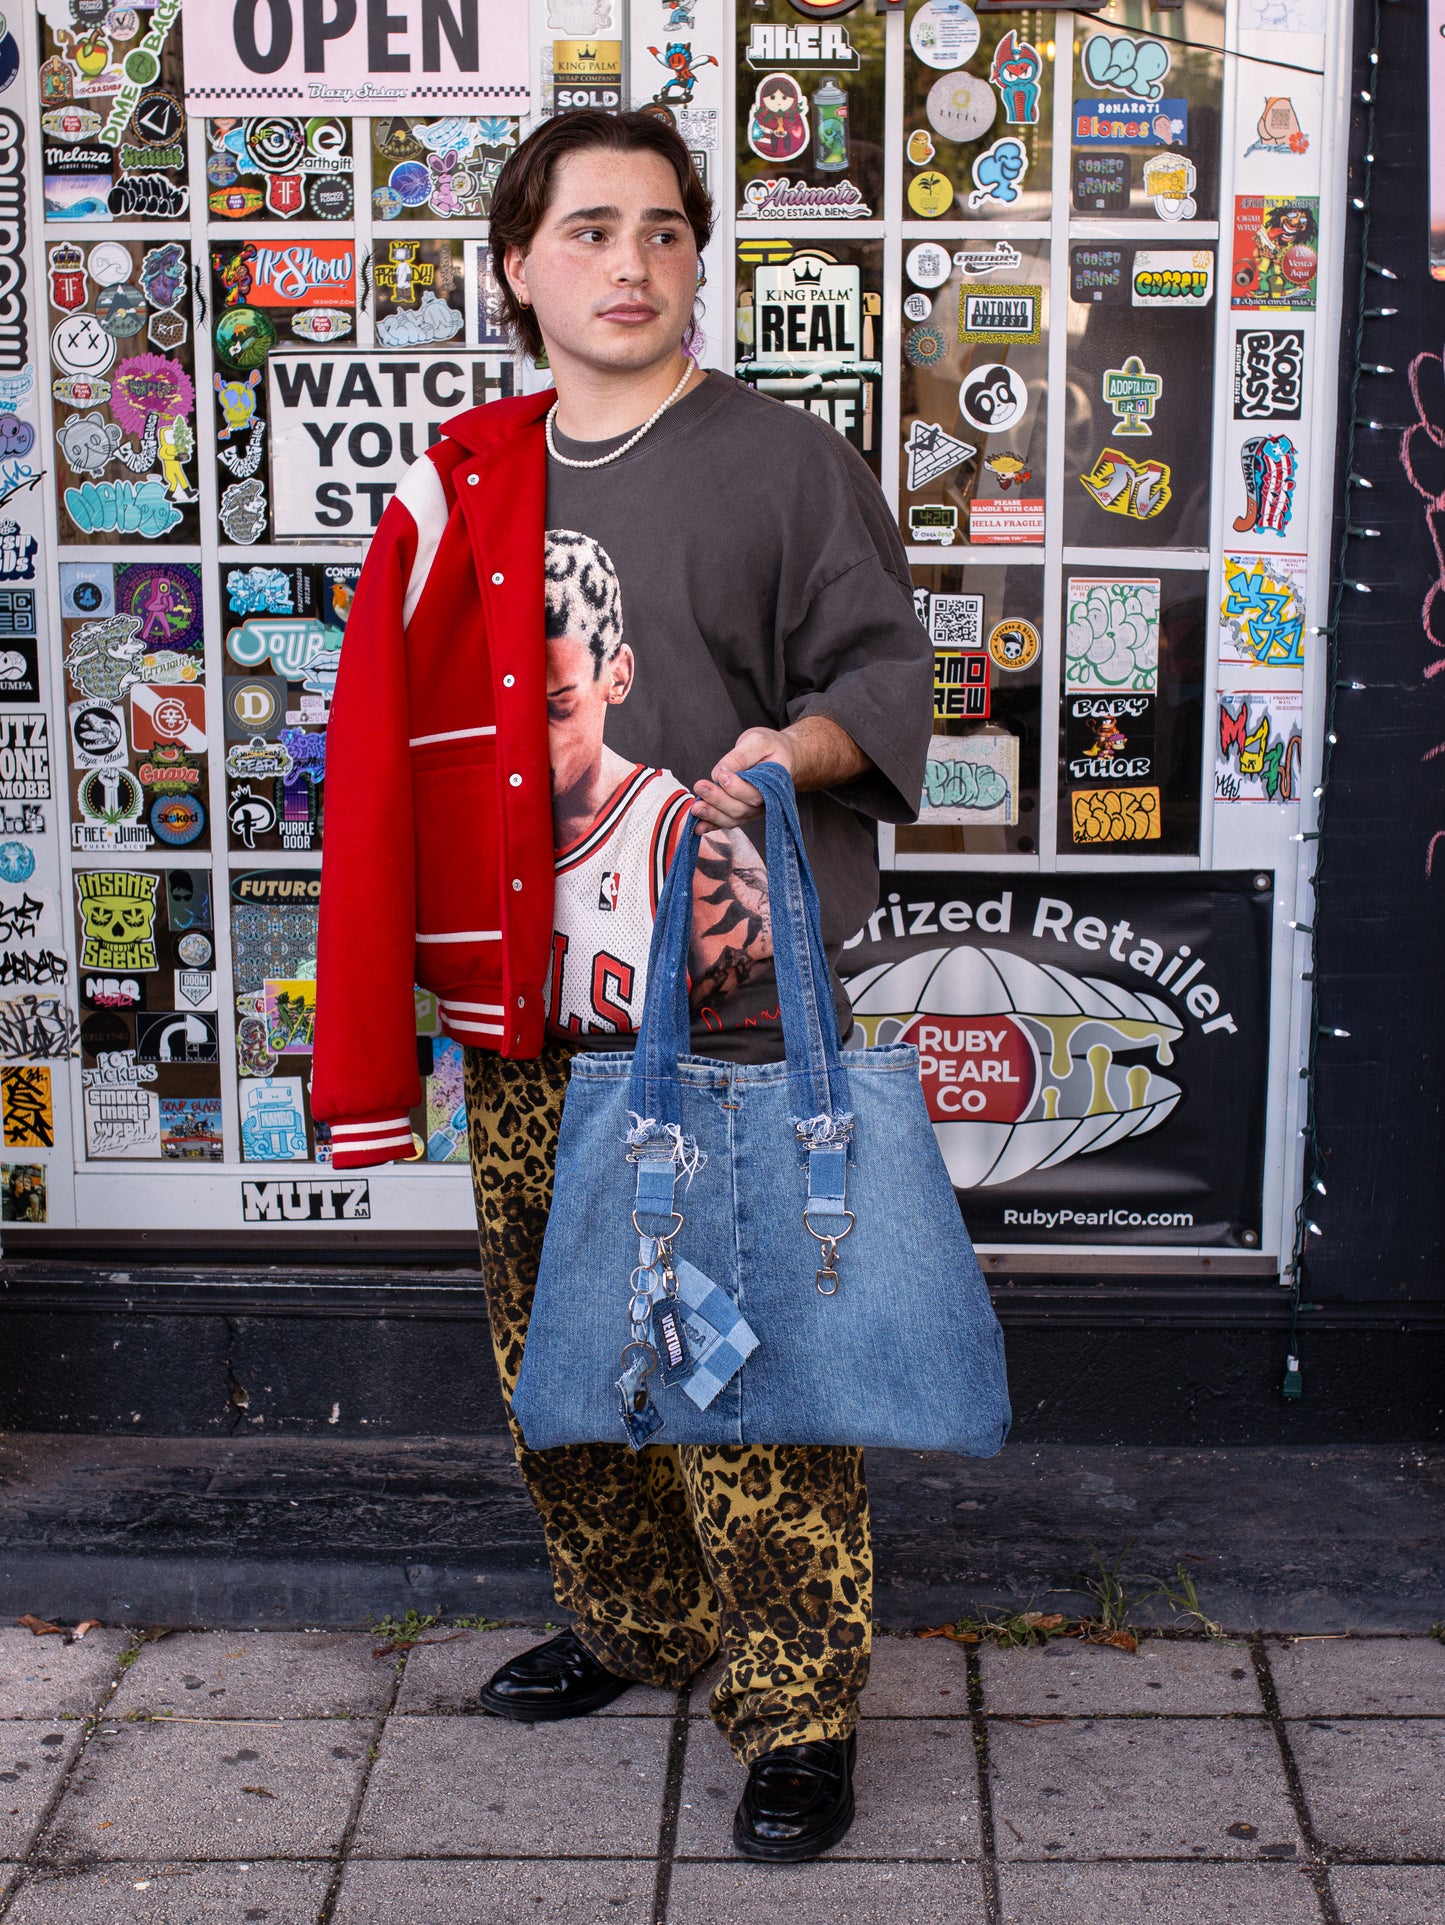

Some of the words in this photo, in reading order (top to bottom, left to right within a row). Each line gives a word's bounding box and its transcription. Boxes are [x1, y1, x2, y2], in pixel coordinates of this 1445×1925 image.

[233, 0, 480, 73] OPEN
[558, 61, 588, 71] KING
[589, 61, 616, 71] PALM
[557, 90, 619, 107] SOLD
[758, 208, 785, 217] TODO
[824, 207, 845, 217] BIEN
[766, 290, 805, 301] KING
[810, 290, 850, 301] PALM
[973, 301, 1027, 315] ANTONYO
[761, 304, 855, 352] REAL
[273, 362, 514, 408] WATCH
[1110, 379, 1141, 396] ADOPTA
[1141, 381, 1158, 394] LOCAL
[1073, 698, 1150, 717] BABY
[139, 764, 199, 785] Guava
[1069, 758, 1150, 778] THOR
[74, 825, 108, 844] FREE
[114, 826, 153, 844] JUANA
[279, 822, 314, 836] PURPLE
[283, 836, 311, 849] DOOR
[79, 873, 157, 898] INSANE
[1031, 896, 1240, 1037] Retailer
[184, 975, 208, 986] DOOM
[918, 1025, 1008, 1052] RUBY
[98, 1051, 136, 1068] POT
[918, 1055, 1021, 1083] PEARL
[82, 1064, 157, 1086] STICKERS
[243, 1181, 369, 1220] MUTZ
[1003, 1208, 1194, 1229] RubyPearlCo.com
[661, 1312, 684, 1369] VENTURA
